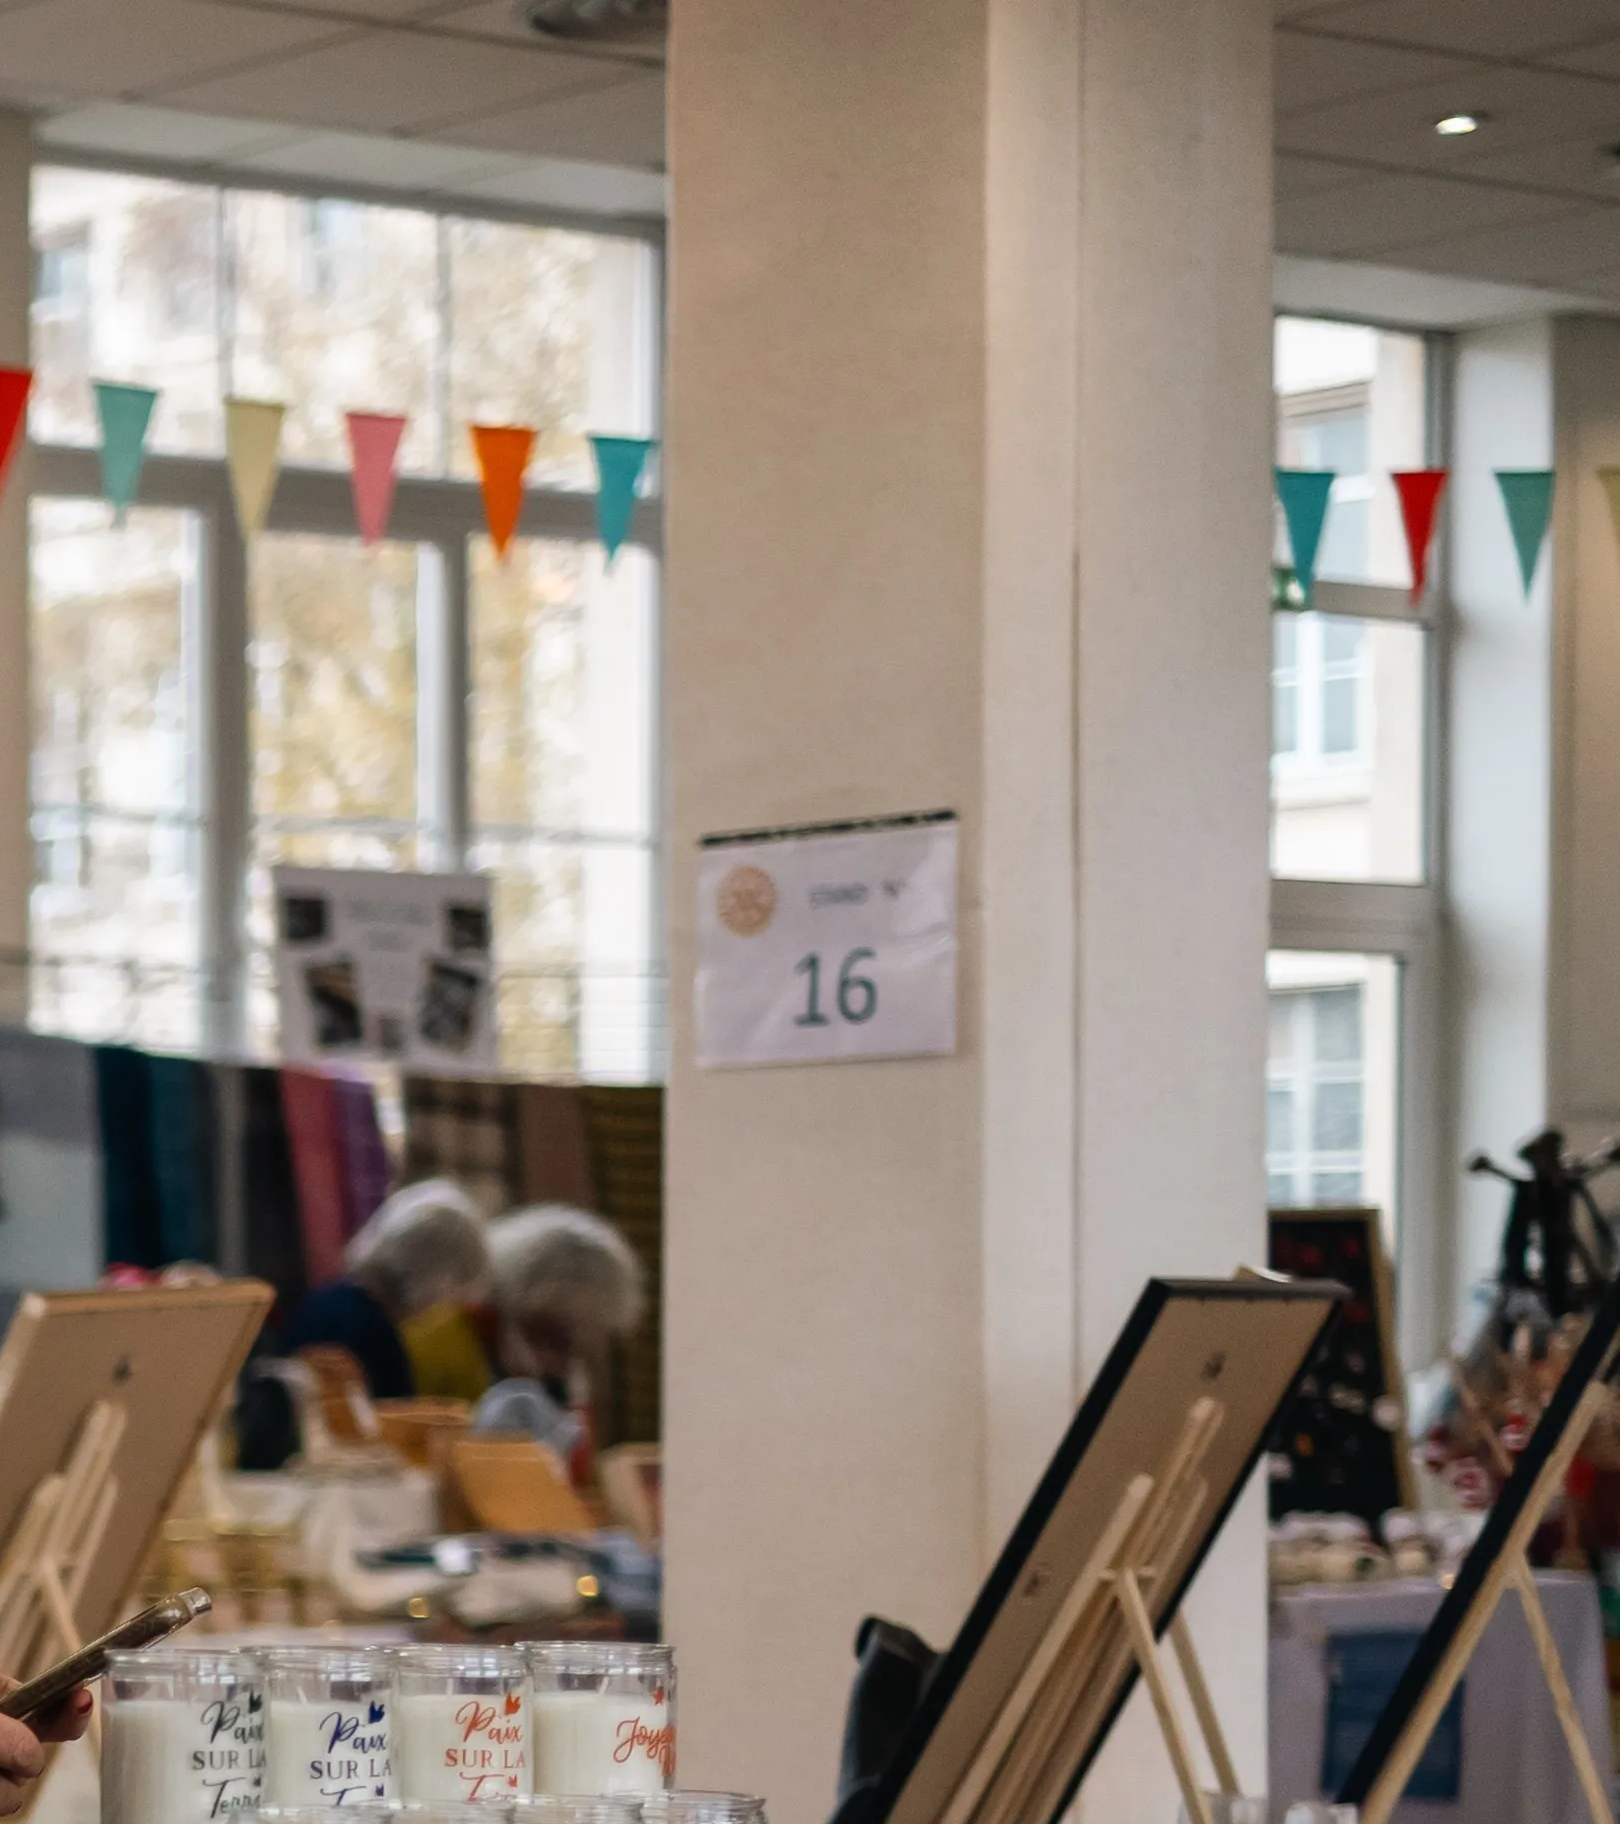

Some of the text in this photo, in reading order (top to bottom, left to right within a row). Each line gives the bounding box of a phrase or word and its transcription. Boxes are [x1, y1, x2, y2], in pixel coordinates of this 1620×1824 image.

[792, 946, 878, 1028] 16
[200, 1701, 263, 1743] Paix
[319, 1712, 388, 1754] Paix
[455, 1701, 523, 1744] Paix
[191, 1749, 267, 1771] SUR LA
[309, 1759, 393, 1780] SUR LA
[444, 1748, 526, 1769] SUR LA
